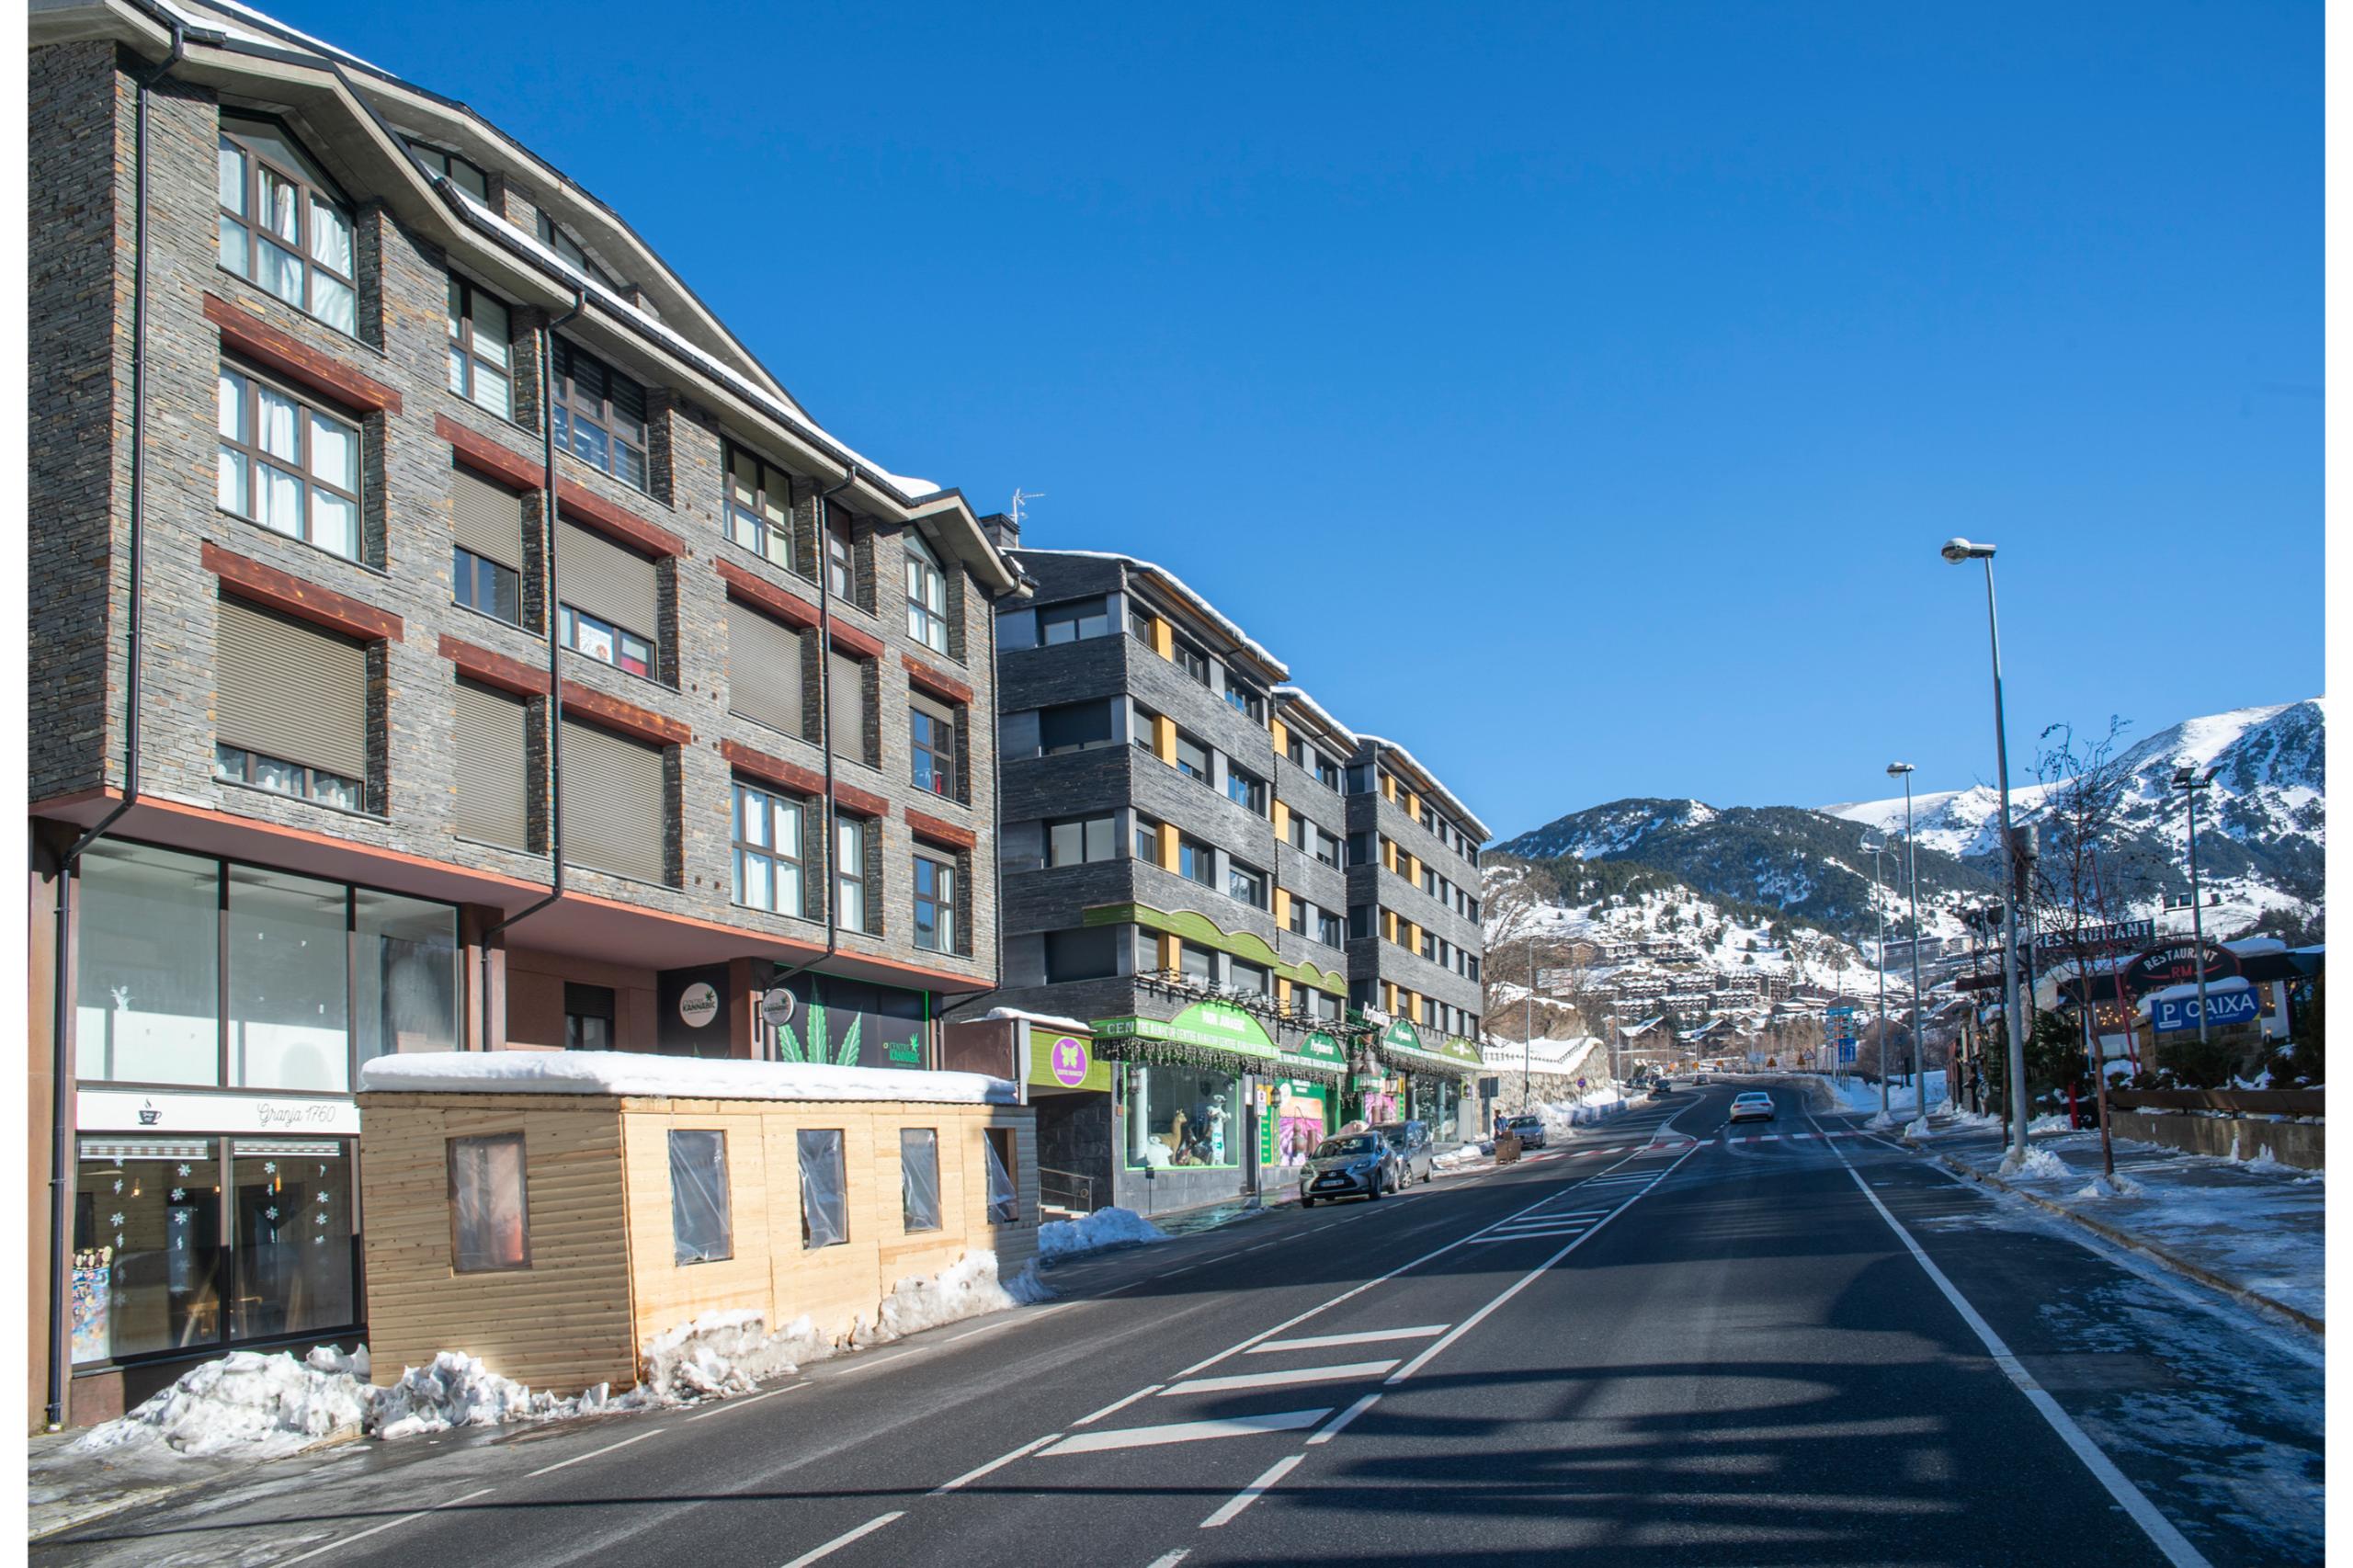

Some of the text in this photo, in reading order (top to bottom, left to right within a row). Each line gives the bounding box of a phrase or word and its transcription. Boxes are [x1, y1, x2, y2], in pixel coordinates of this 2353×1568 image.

[2143, 947, 2218, 971] RESTAURNT
[2171, 965, 2192, 978] RM
[2163, 994, 2256, 1021] P CAIXA
[257, 1103, 335, 1127] Granja 1760
